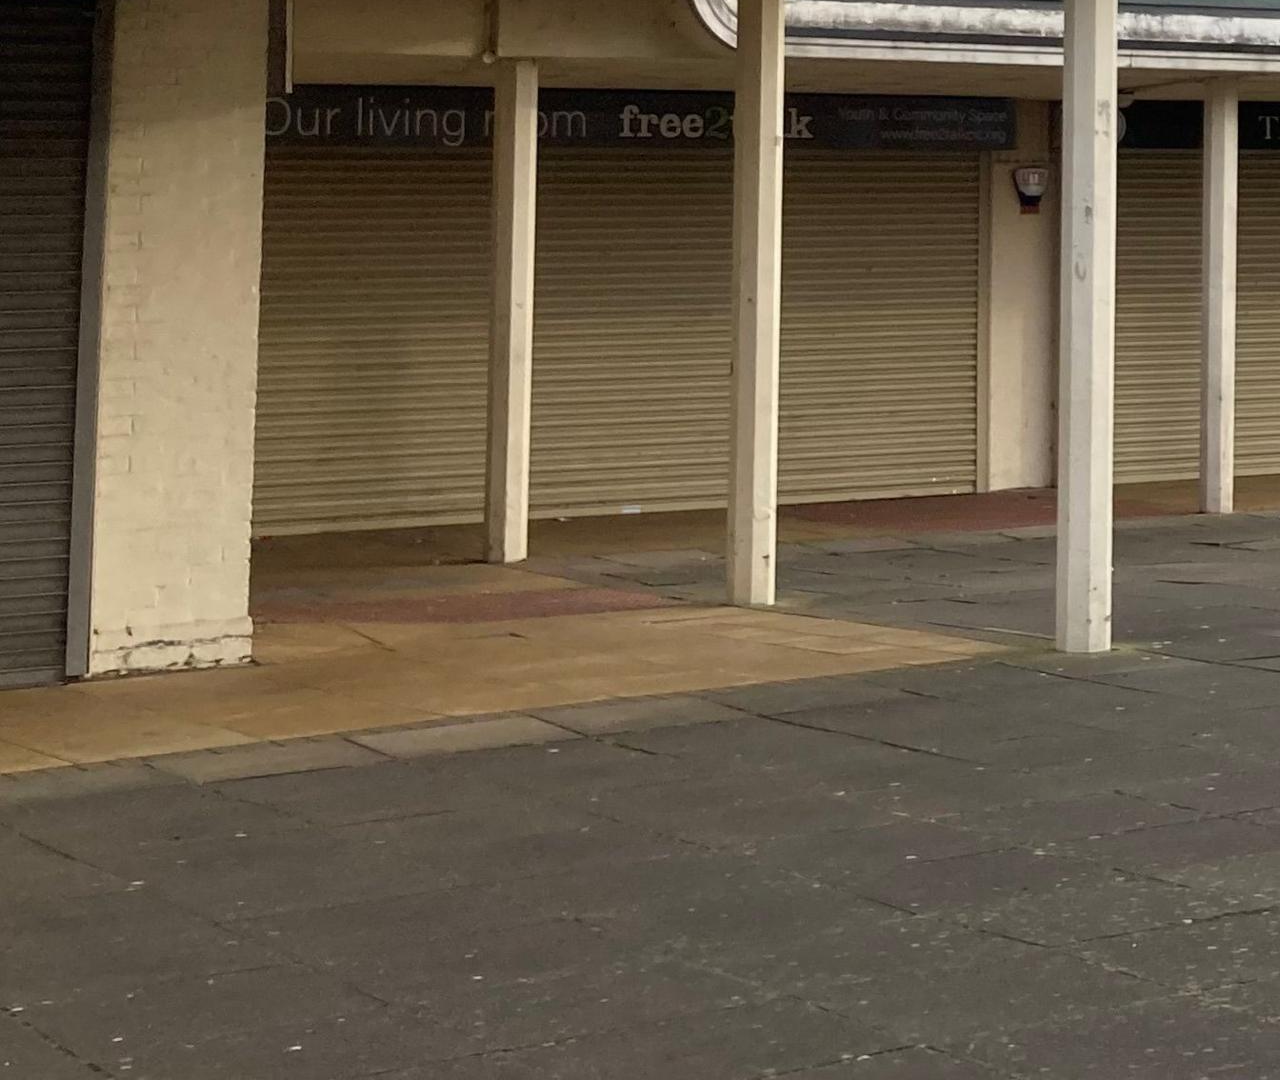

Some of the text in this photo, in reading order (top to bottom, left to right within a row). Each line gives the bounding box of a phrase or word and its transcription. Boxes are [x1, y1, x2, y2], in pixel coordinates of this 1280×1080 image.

[265, 97, 587, 147] Our living rm
[619, 104, 814, 140] free2k
